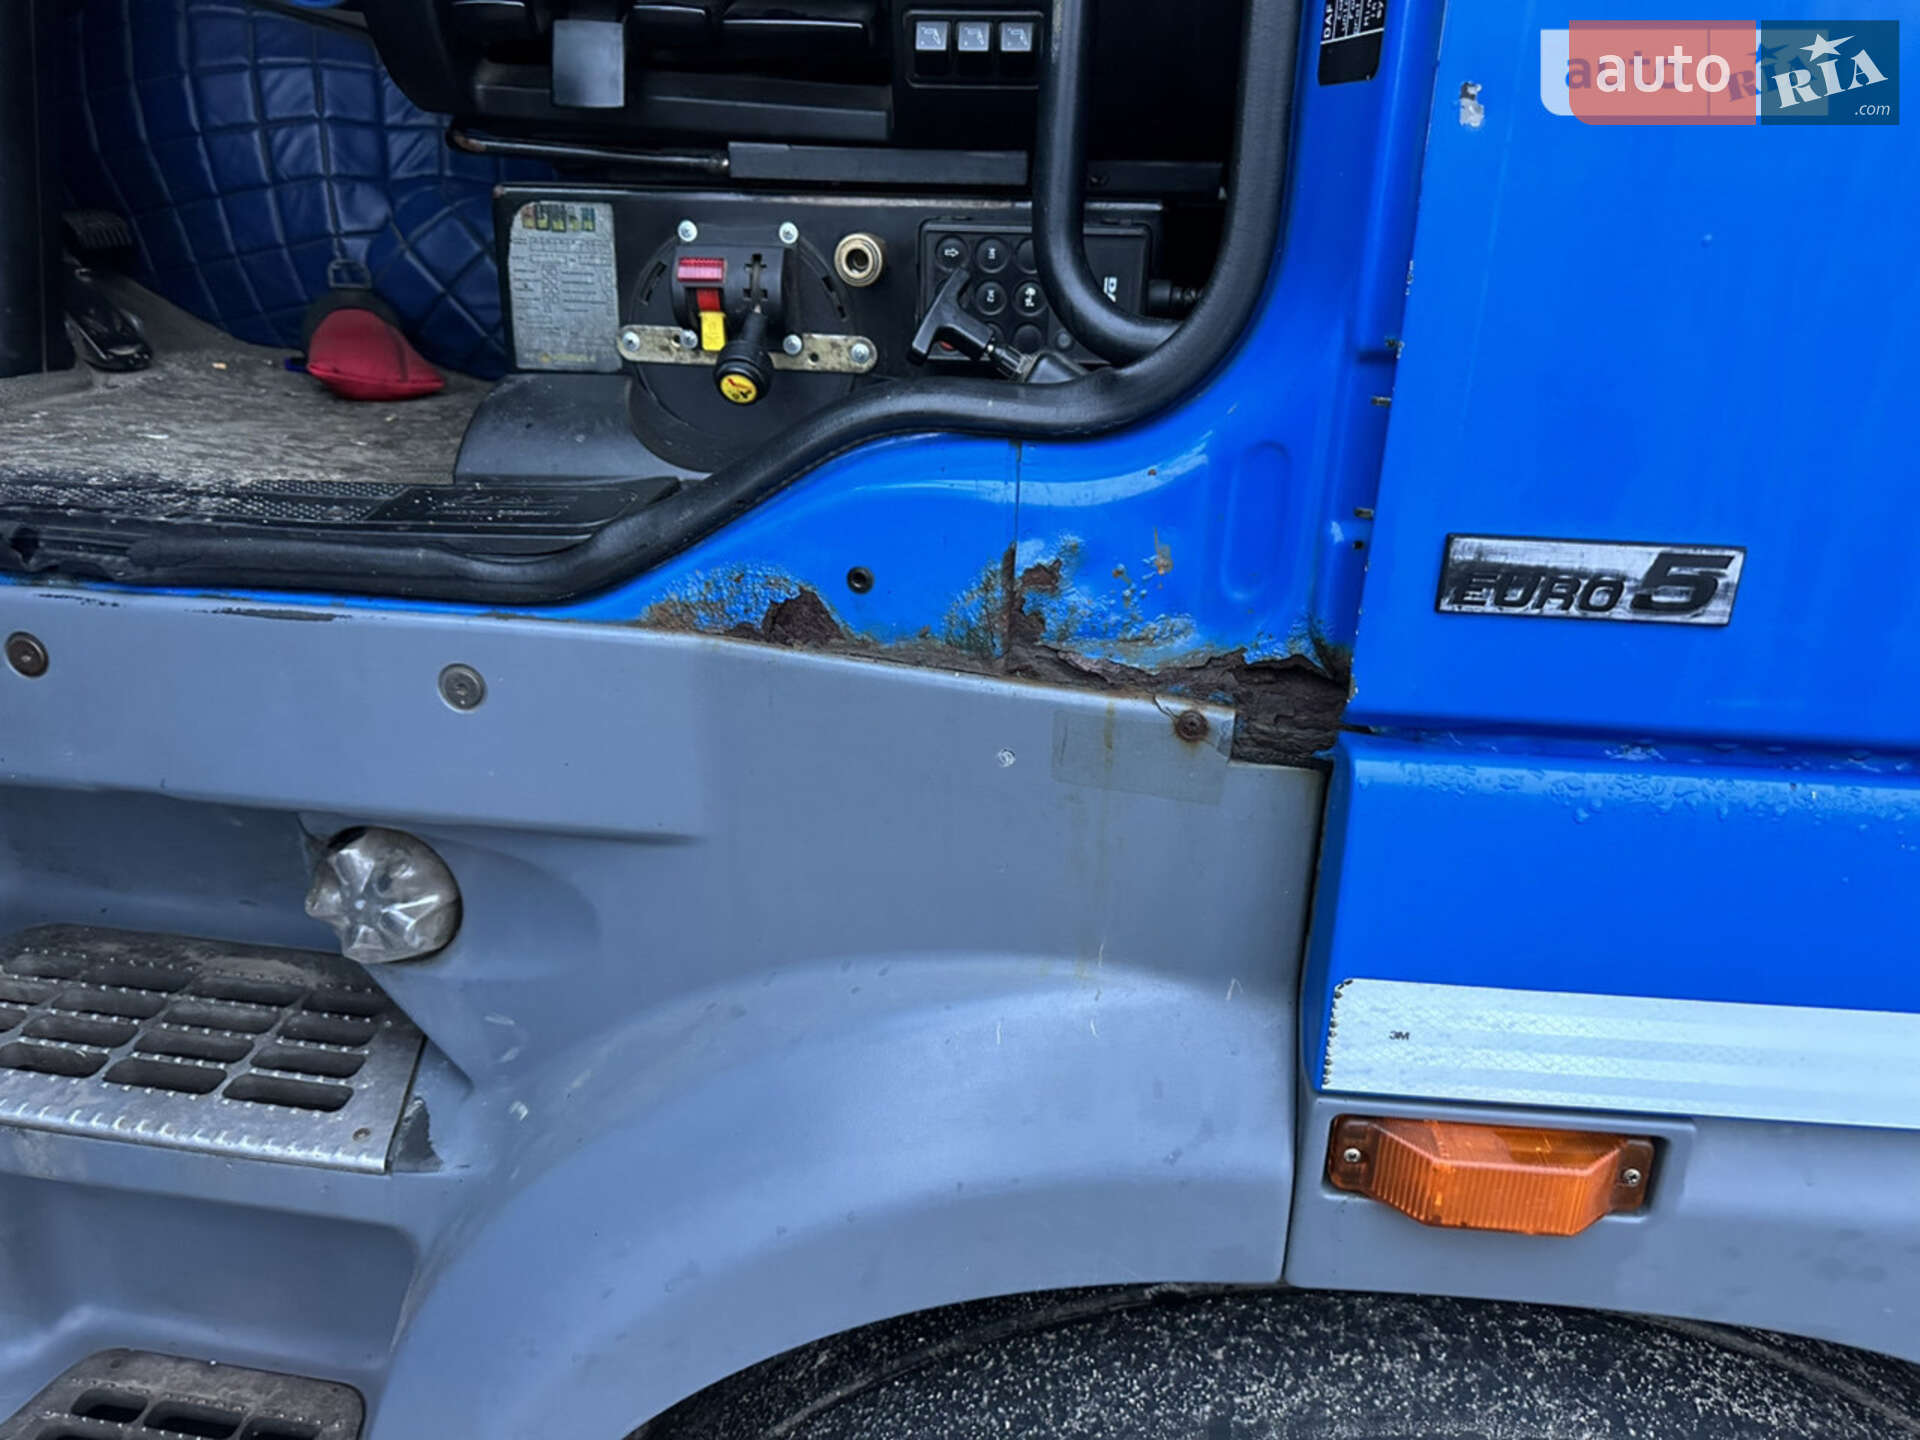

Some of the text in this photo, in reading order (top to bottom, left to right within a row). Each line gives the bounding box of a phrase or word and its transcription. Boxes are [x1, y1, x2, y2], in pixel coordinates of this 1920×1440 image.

[1450, 552, 1735, 616] EURO 5
[1389, 1030, 1410, 1041] 3M
